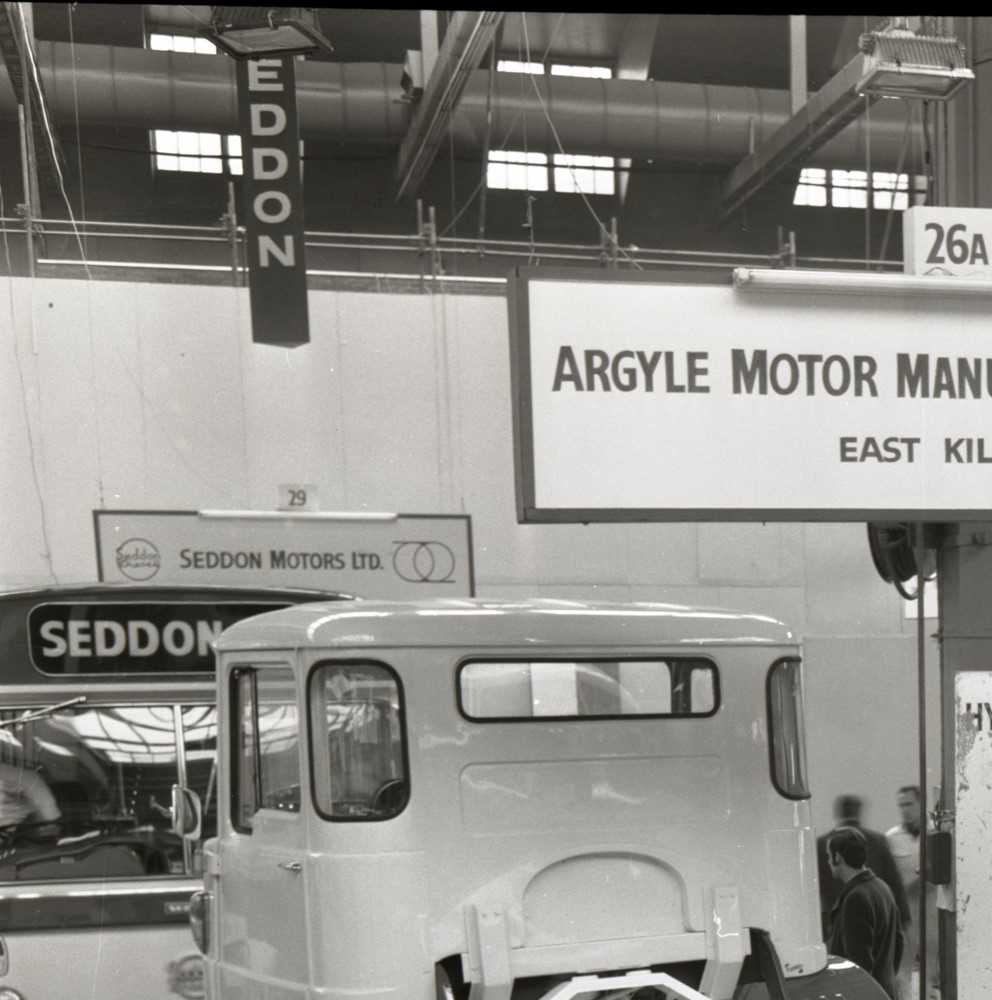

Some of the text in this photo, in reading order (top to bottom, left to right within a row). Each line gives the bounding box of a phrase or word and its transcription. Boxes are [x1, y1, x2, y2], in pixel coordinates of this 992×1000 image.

[248, 57, 296, 267] EDDON
[925, 222, 989, 265] 26A
[552, 345, 710, 393] ARGYLE
[731, 348, 878, 397] MOTOR
[839, 437, 920, 463] EAST
[287, 489, 307, 507] 29
[180, 549, 262, 569] SEDDON
[270, 551, 345, 570] MOTORS
[352, 552, 384, 570] LTD.
[40, 620, 222, 657] SEDDON
